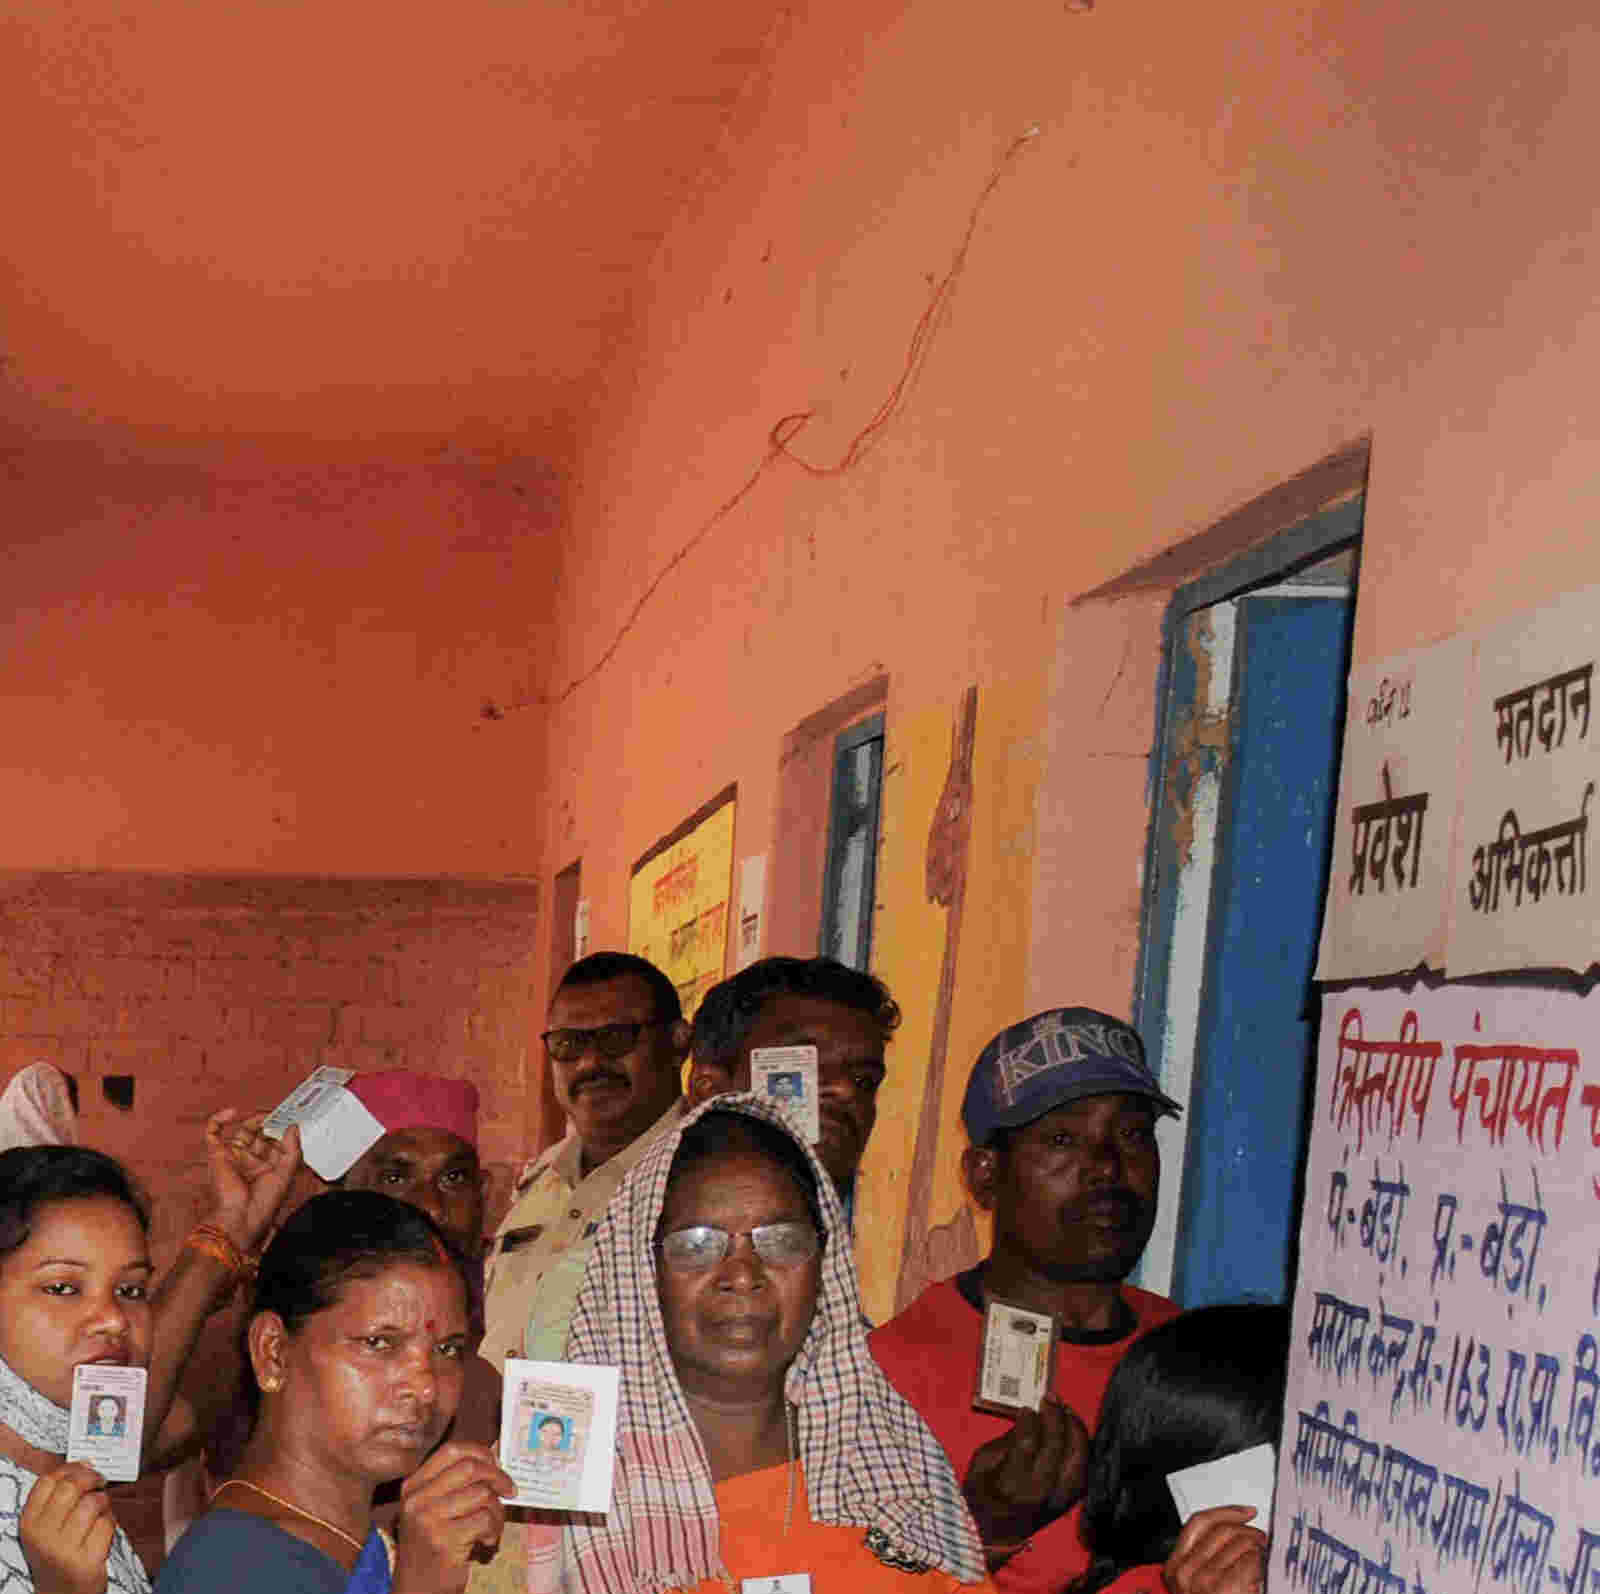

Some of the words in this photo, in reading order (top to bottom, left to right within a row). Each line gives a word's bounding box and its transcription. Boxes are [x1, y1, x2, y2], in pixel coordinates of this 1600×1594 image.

[1493, 661, 1594, 765] मतदान
[1349, 758, 1430, 896] प्रवेश
[1450, 1007, 1580, 1155] पंचायत
